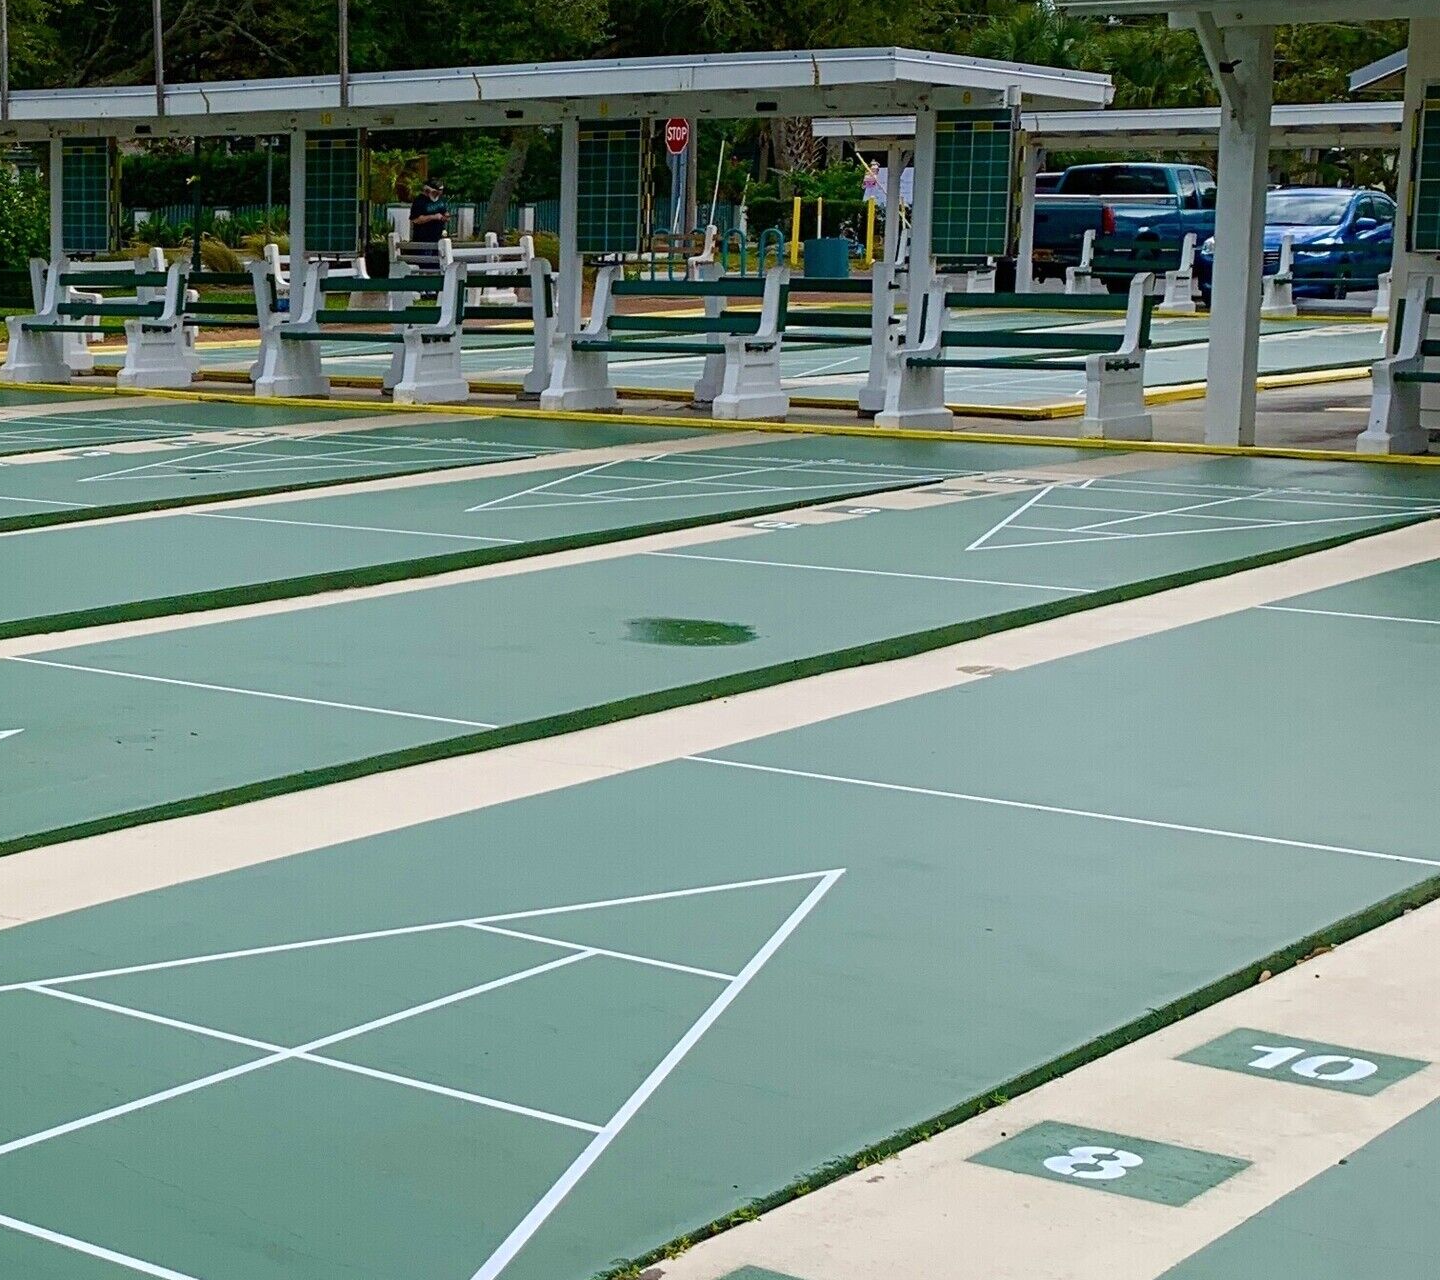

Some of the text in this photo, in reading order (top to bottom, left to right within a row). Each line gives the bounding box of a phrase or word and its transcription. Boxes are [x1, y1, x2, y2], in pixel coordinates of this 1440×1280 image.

[667, 126, 688, 141] STOP
[1248, 1045, 1378, 1081] 10
[1043, 1146, 1143, 1179] 8
